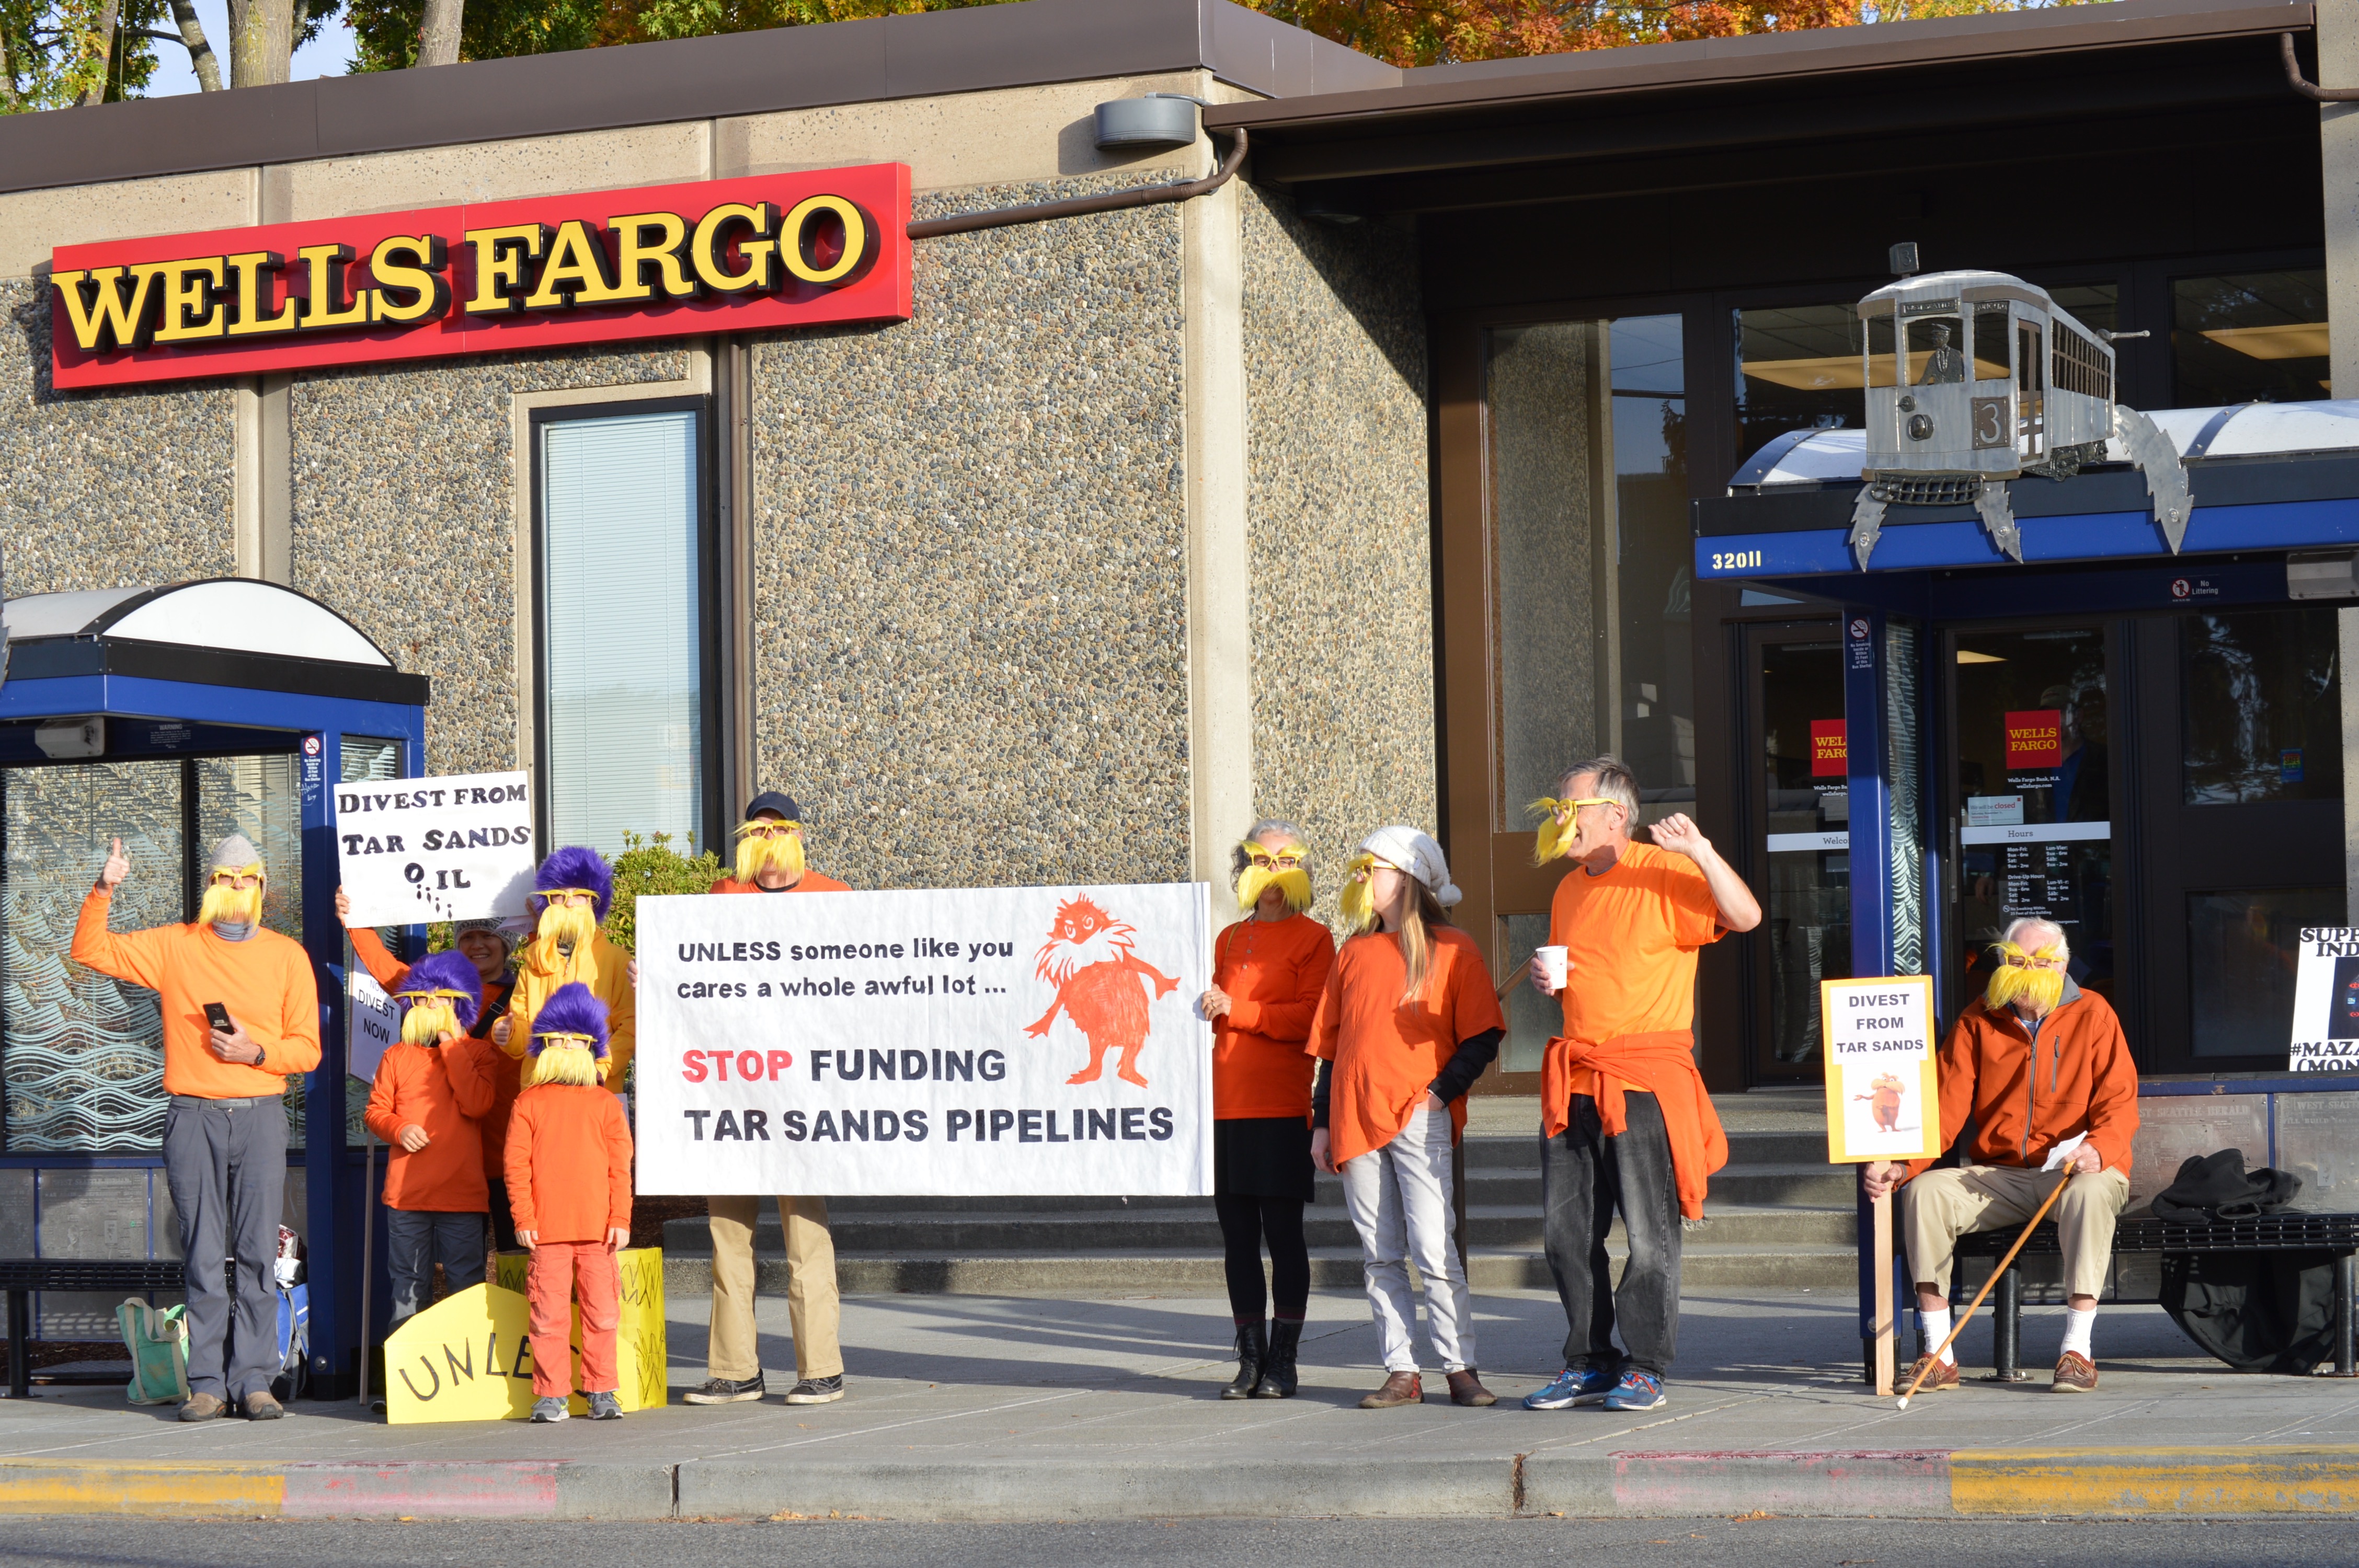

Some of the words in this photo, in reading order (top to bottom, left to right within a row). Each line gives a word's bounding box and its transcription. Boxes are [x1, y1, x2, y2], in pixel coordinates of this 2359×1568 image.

[1902, 250, 1911, 266] 3
[51, 235, 447, 353] WELLS
[464, 193, 875, 316] FARGO
[1980, 403, 2002, 443] 3
[1712, 550, 1761, 570] 32011
[1815, 736, 1847, 747] WEL
[2009, 728, 2057, 739] WELLS
[2011, 740, 2057, 751] FARGO
[339, 789, 445, 814] DIVEST
[453, 784, 526, 805] FROM
[342, 833, 406, 856] TAR
[422, 826, 531, 851] SANDS
[678, 941, 781, 963] UNLESS
[791, 940, 904, 961] someone
[913, 938, 959, 959] like
[968, 940, 1014, 963] you
[2316, 942, 2359, 957] IND
[677, 978, 747, 1000] cares
[757, 982, 772, 998] a
[781, 976, 856, 998] whole
[864, 975, 934, 996] awful
[943, 975, 976, 995] lot
[358, 988, 395, 1020] DIVEST
[1849, 994, 1910, 1008] DIVEST
[363, 1018, 390, 1044] NOW
[1856, 1017, 1904, 1030] FROM
[1836, 1042, 1867, 1053] TAR
[1872, 1039, 1924, 1051] SANDS
[682, 1049, 793, 1083] STOP
[811, 1048, 1006, 1082] FUNDING
[2157, 1106, 2202, 1117] SEATTLE
[2207, 1104, 2250, 1116] HERALD
[2297, 1101, 2324, 1110] WEST
[684, 1109, 770, 1143] TAR
[783, 1109, 929, 1143] SANDS
[947, 1106, 1174, 1144] PIPELINES
